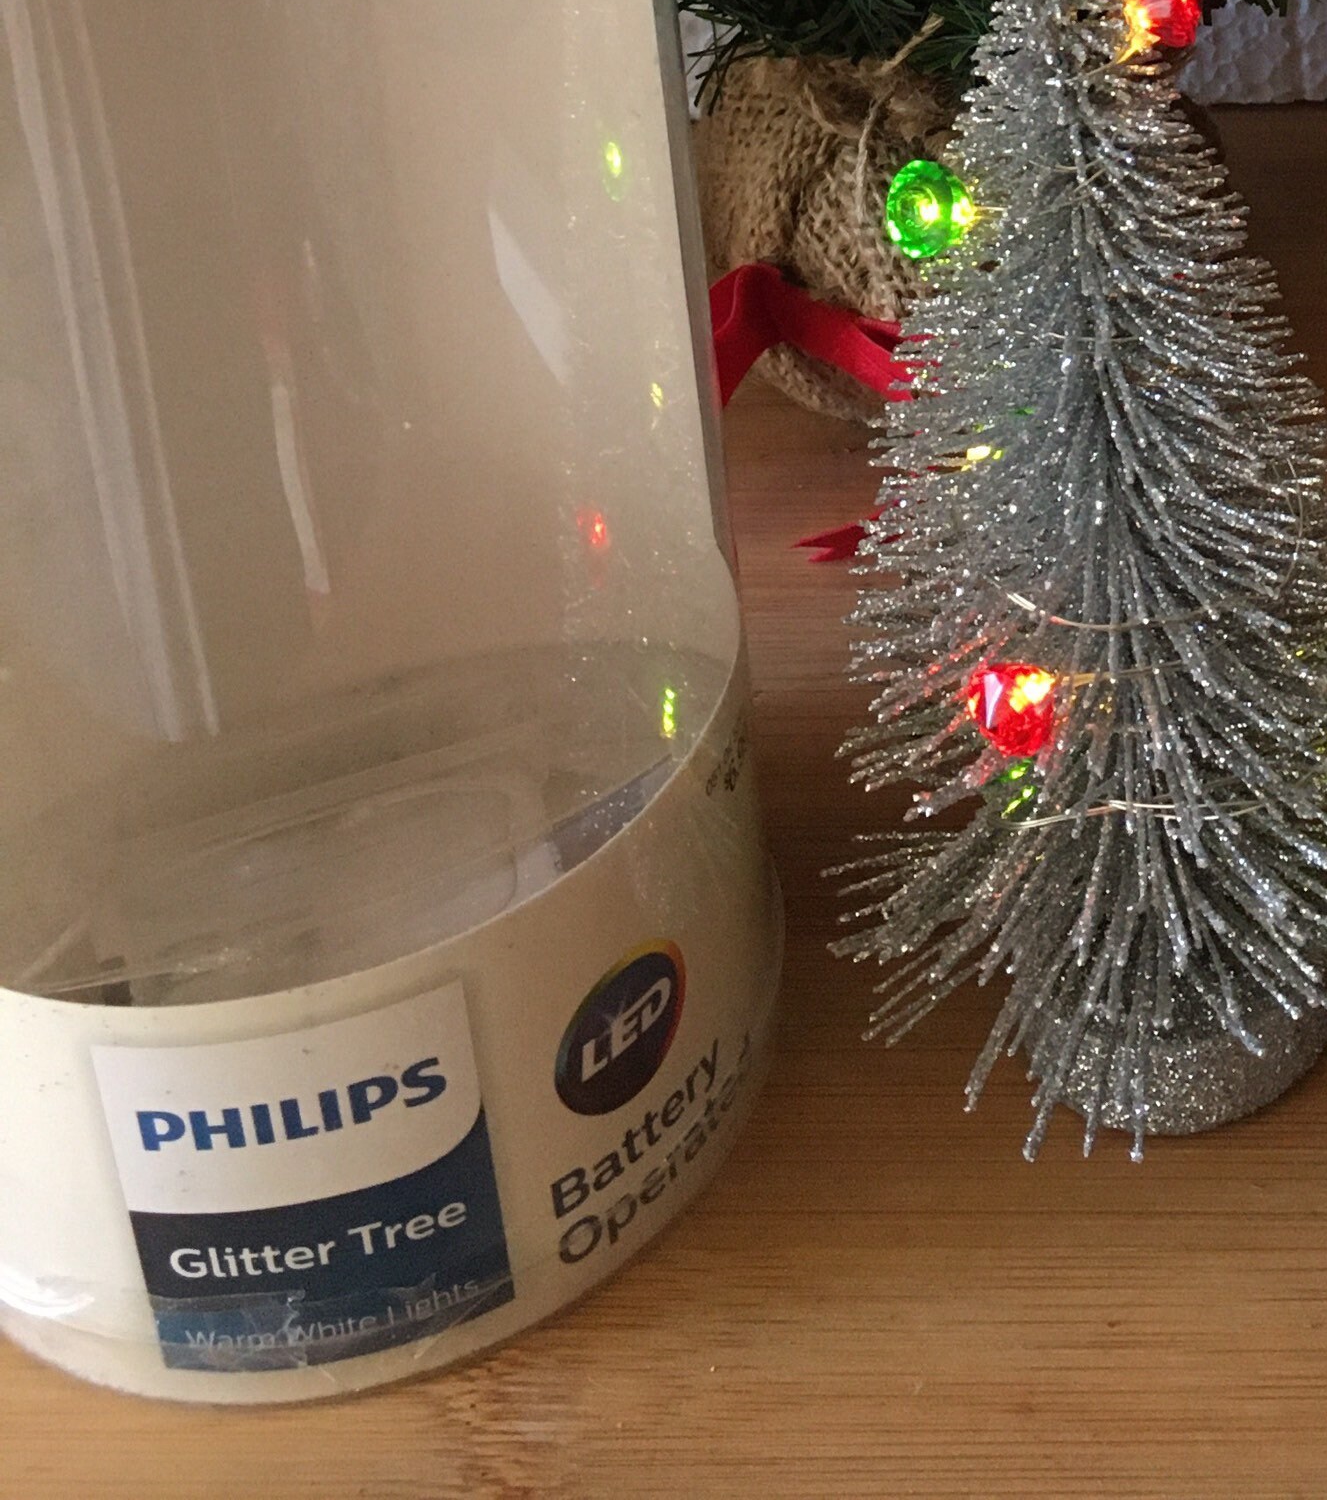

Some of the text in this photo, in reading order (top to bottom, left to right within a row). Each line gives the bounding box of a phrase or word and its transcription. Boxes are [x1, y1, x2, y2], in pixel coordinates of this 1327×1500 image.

[581, 976, 672, 1083] LED
[136, 1057, 447, 1152] PHILIPS
[551, 1038, 718, 1219] Battery
[169, 1201, 468, 1279] Glitter Tree
[184, 1329, 289, 1348] Warm
[292, 1316, 378, 1343] White
